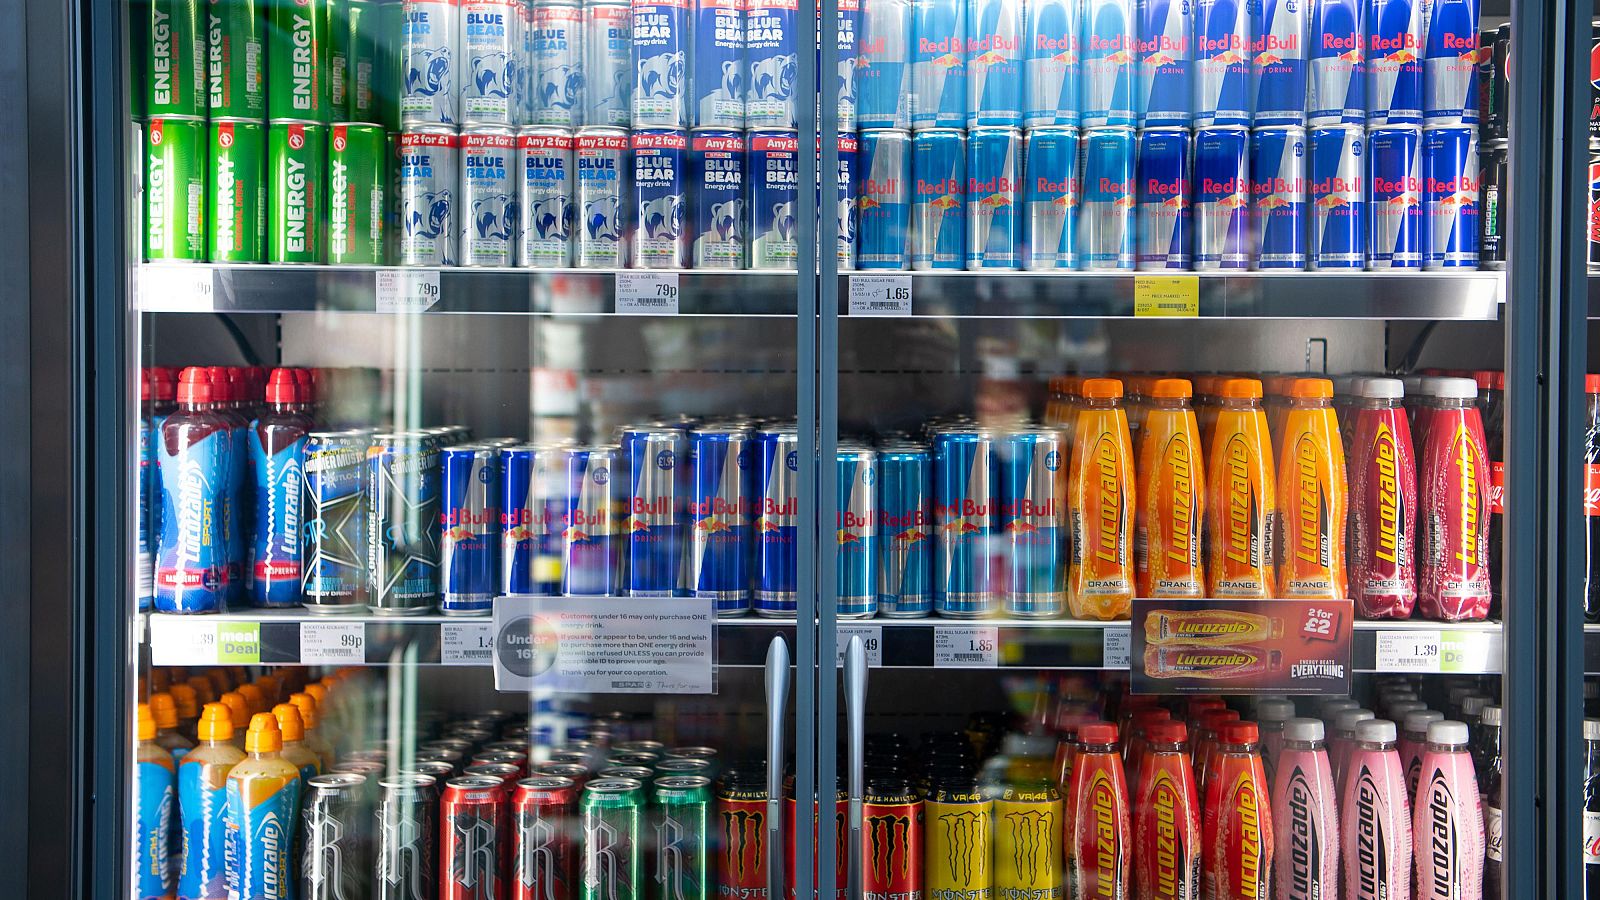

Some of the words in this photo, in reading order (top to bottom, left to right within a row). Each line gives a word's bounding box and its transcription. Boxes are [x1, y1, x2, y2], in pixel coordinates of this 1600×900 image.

[467, 14, 503, 25] BLUE
[634, 14, 669, 26] BLUE
[467, 25, 505, 37] BEAR
[634, 26, 671, 38] BEAR
[1267, 34, 1297, 50] Bull
[1323, 33, 1354, 49] Red
[1371, 32, 1402, 50] Red
[1443, 33, 1474, 49] Red
[154, 9, 170, 105] ENERGY
[210, 14, 222, 108] ENERGY
[293, 14, 311, 110] ENERGY
[413, 135, 421, 145] 2
[421, 134, 437, 144] for
[437, 135, 449, 145] £1
[467, 136, 486, 147] Any
[487, 136, 494, 145] 2
[526, 137, 546, 148] Any
[546, 138, 554, 146] 2
[578, 137, 596, 149] Any
[597, 137, 604, 147] 2
[605, 137, 620, 147] for
[636, 136, 653, 147] Any
[655, 136, 662, 145] 2
[663, 136, 678, 146] for
[705, 139, 725, 149] Any
[726, 139, 733, 148] 2
[767, 139, 786, 150] Any
[787, 139, 795, 149] 2
[467, 156, 504, 167] BLUE
[526, 157, 563, 169] BLUE
[578, 158, 615, 169] BLUE
[636, 157, 673, 168] BLUE
[705, 160, 740, 171] BLUE
[467, 168, 506, 179] BEAR
[526, 169, 565, 180] BEAR
[578, 170, 616, 180] BEAR
[636, 168, 674, 180] BEAR
[705, 171, 741, 183] BEAR
[917, 178, 946, 195] Red
[969, 177, 996, 193] Red
[1037, 177, 1067, 193] Red
[1149, 178, 1179, 195] Red
[1203, 177, 1234, 194] Red
[1333, 177, 1361, 193] Bull
[1375, 176, 1405, 193] Red
[1427, 176, 1456, 193] Red
[150, 154, 164, 250] ENERGY
[217, 155, 235, 252] ENERGY
[287, 157, 305, 252] ENERGY
[332, 159, 348, 255] ENERGY
[417, 282, 438, 296] 79p
[655, 284, 677, 298] 79p
[886, 287, 910, 300] 1.65
[634, 497, 668, 515] Bull
[1021, 499, 1056, 517] Bull
[1096, 446, 1117, 564] Lucozade
[1168, 443, 1191, 565] Lucozade
[1226, 445, 1249, 565] Lucozade
[1296, 445, 1318, 565] Lucozade
[1375, 442, 1396, 563] Lucozade
[281, 470, 300, 555] Lucozade
[202, 498, 212, 546] SPORT
[1218, 581, 1258, 589] ORANGE
[1289, 581, 1329, 589] ORANGE
[643, 613, 659, 621] only
[1308, 608, 1316, 617] 2
[1316, 609, 1334, 619] for
[1177, 622, 1245, 633] Lucozade
[1303, 617, 1331, 635] £2
[220, 629, 258, 643] meal
[341, 634, 362, 648] 99p
[479, 636, 493, 648] 1.4
[506, 634, 549, 645] Under
[224, 643, 258, 654] Deal
[969, 639, 993, 651] 1.85
[1414, 644, 1437, 656] 1.39
[516, 648, 539, 659] 16?
[1176, 653, 1245, 665] Lucozade
[1291, 664, 1344, 679] EVERYTHING
[884, 794, 917, 803] HAMILTON
[1092, 790, 1115, 900] ucozade
[1236, 791, 1259, 900] ucozade
[1428, 789, 1450, 900] ucozade
